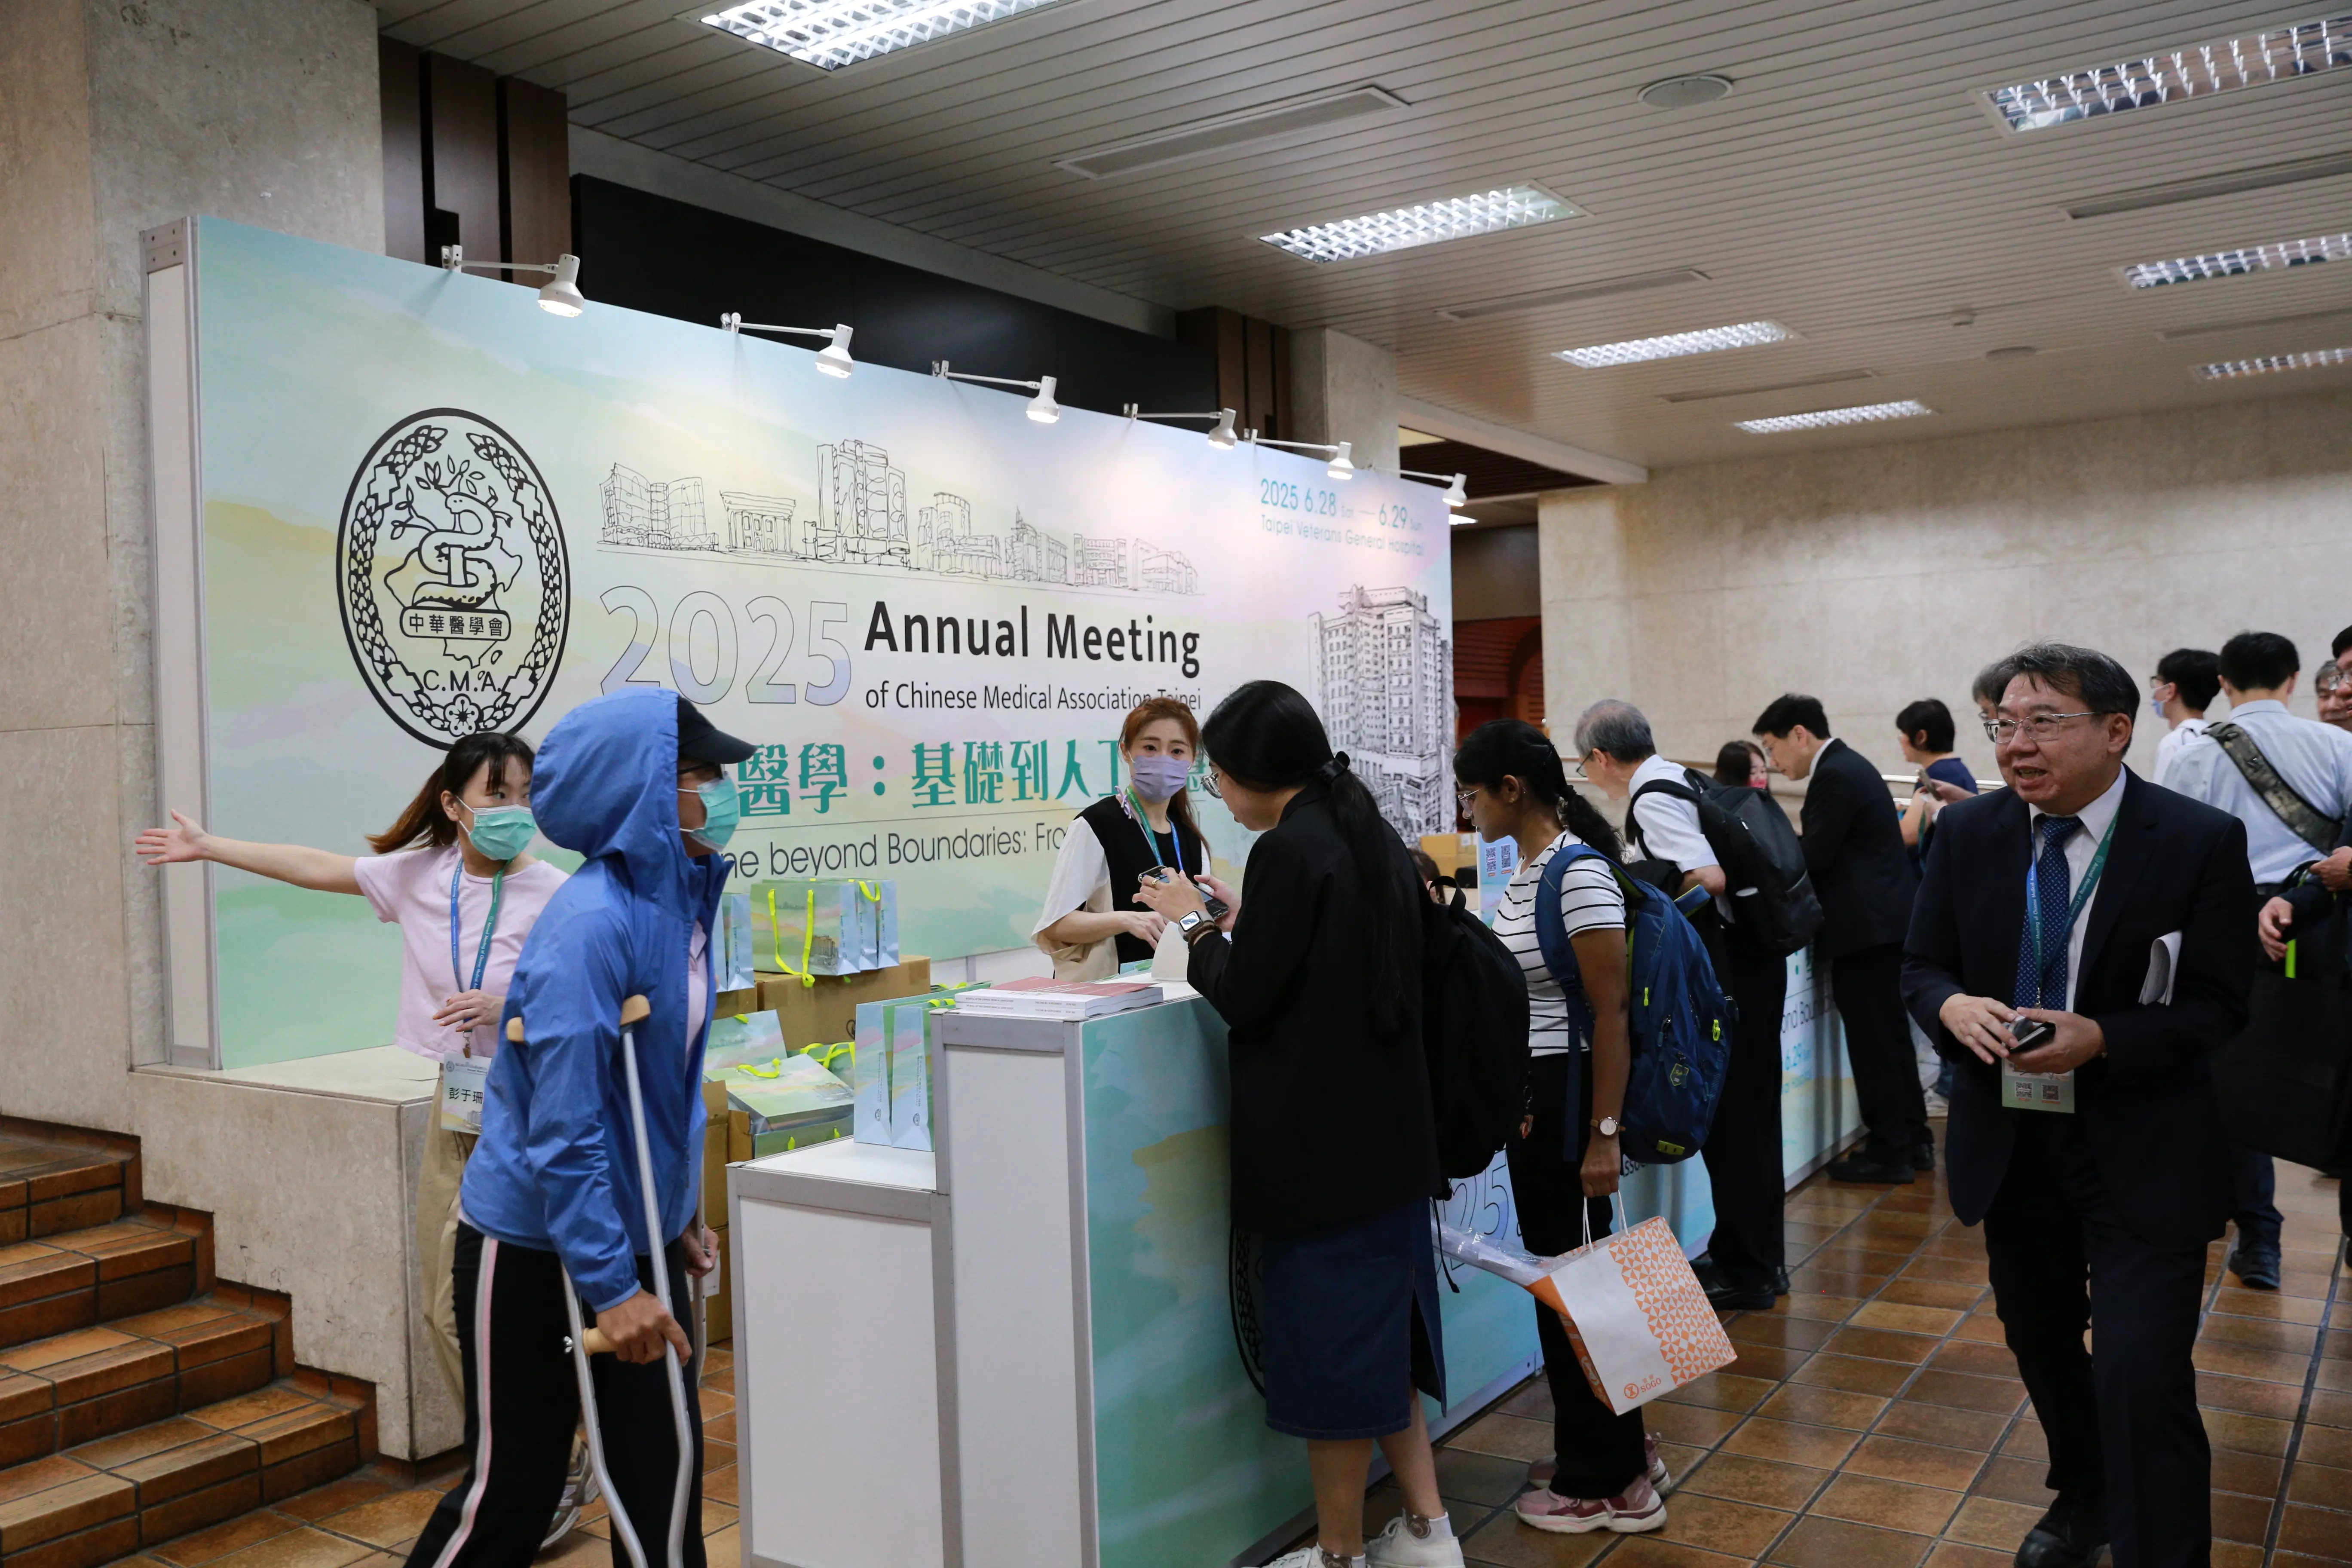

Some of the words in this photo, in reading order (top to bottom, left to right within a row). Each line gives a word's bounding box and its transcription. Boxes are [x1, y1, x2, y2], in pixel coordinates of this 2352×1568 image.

[1260, 478, 1298, 510] 2025
[1304, 487, 1336, 518] 6.28
[1378, 502, 1408, 530] 6.29
[1261, 514, 1293, 536] Taipei
[1296, 519, 1342, 544] Veterans
[1345, 530, 1385, 550] General
[1388, 537, 1424, 556] Hospital
[408, 612, 503, 637] 中華醫學會
[600, 585, 852, 706] 2025
[864, 600, 1029, 658] Annual
[1047, 615, 1200, 679] Meeting
[866, 680, 890, 709] of
[896, 681, 977, 710] Chinese
[984, 684, 1052, 710] Medical
[1157, 688, 1201, 710] Tpei
[771, 834, 878, 878] beyond
[888, 824, 1027, 865] Boundaries:
[1036, 822, 1069, 851] Fro
[1640, 1378, 1661, 1393] SOGO
